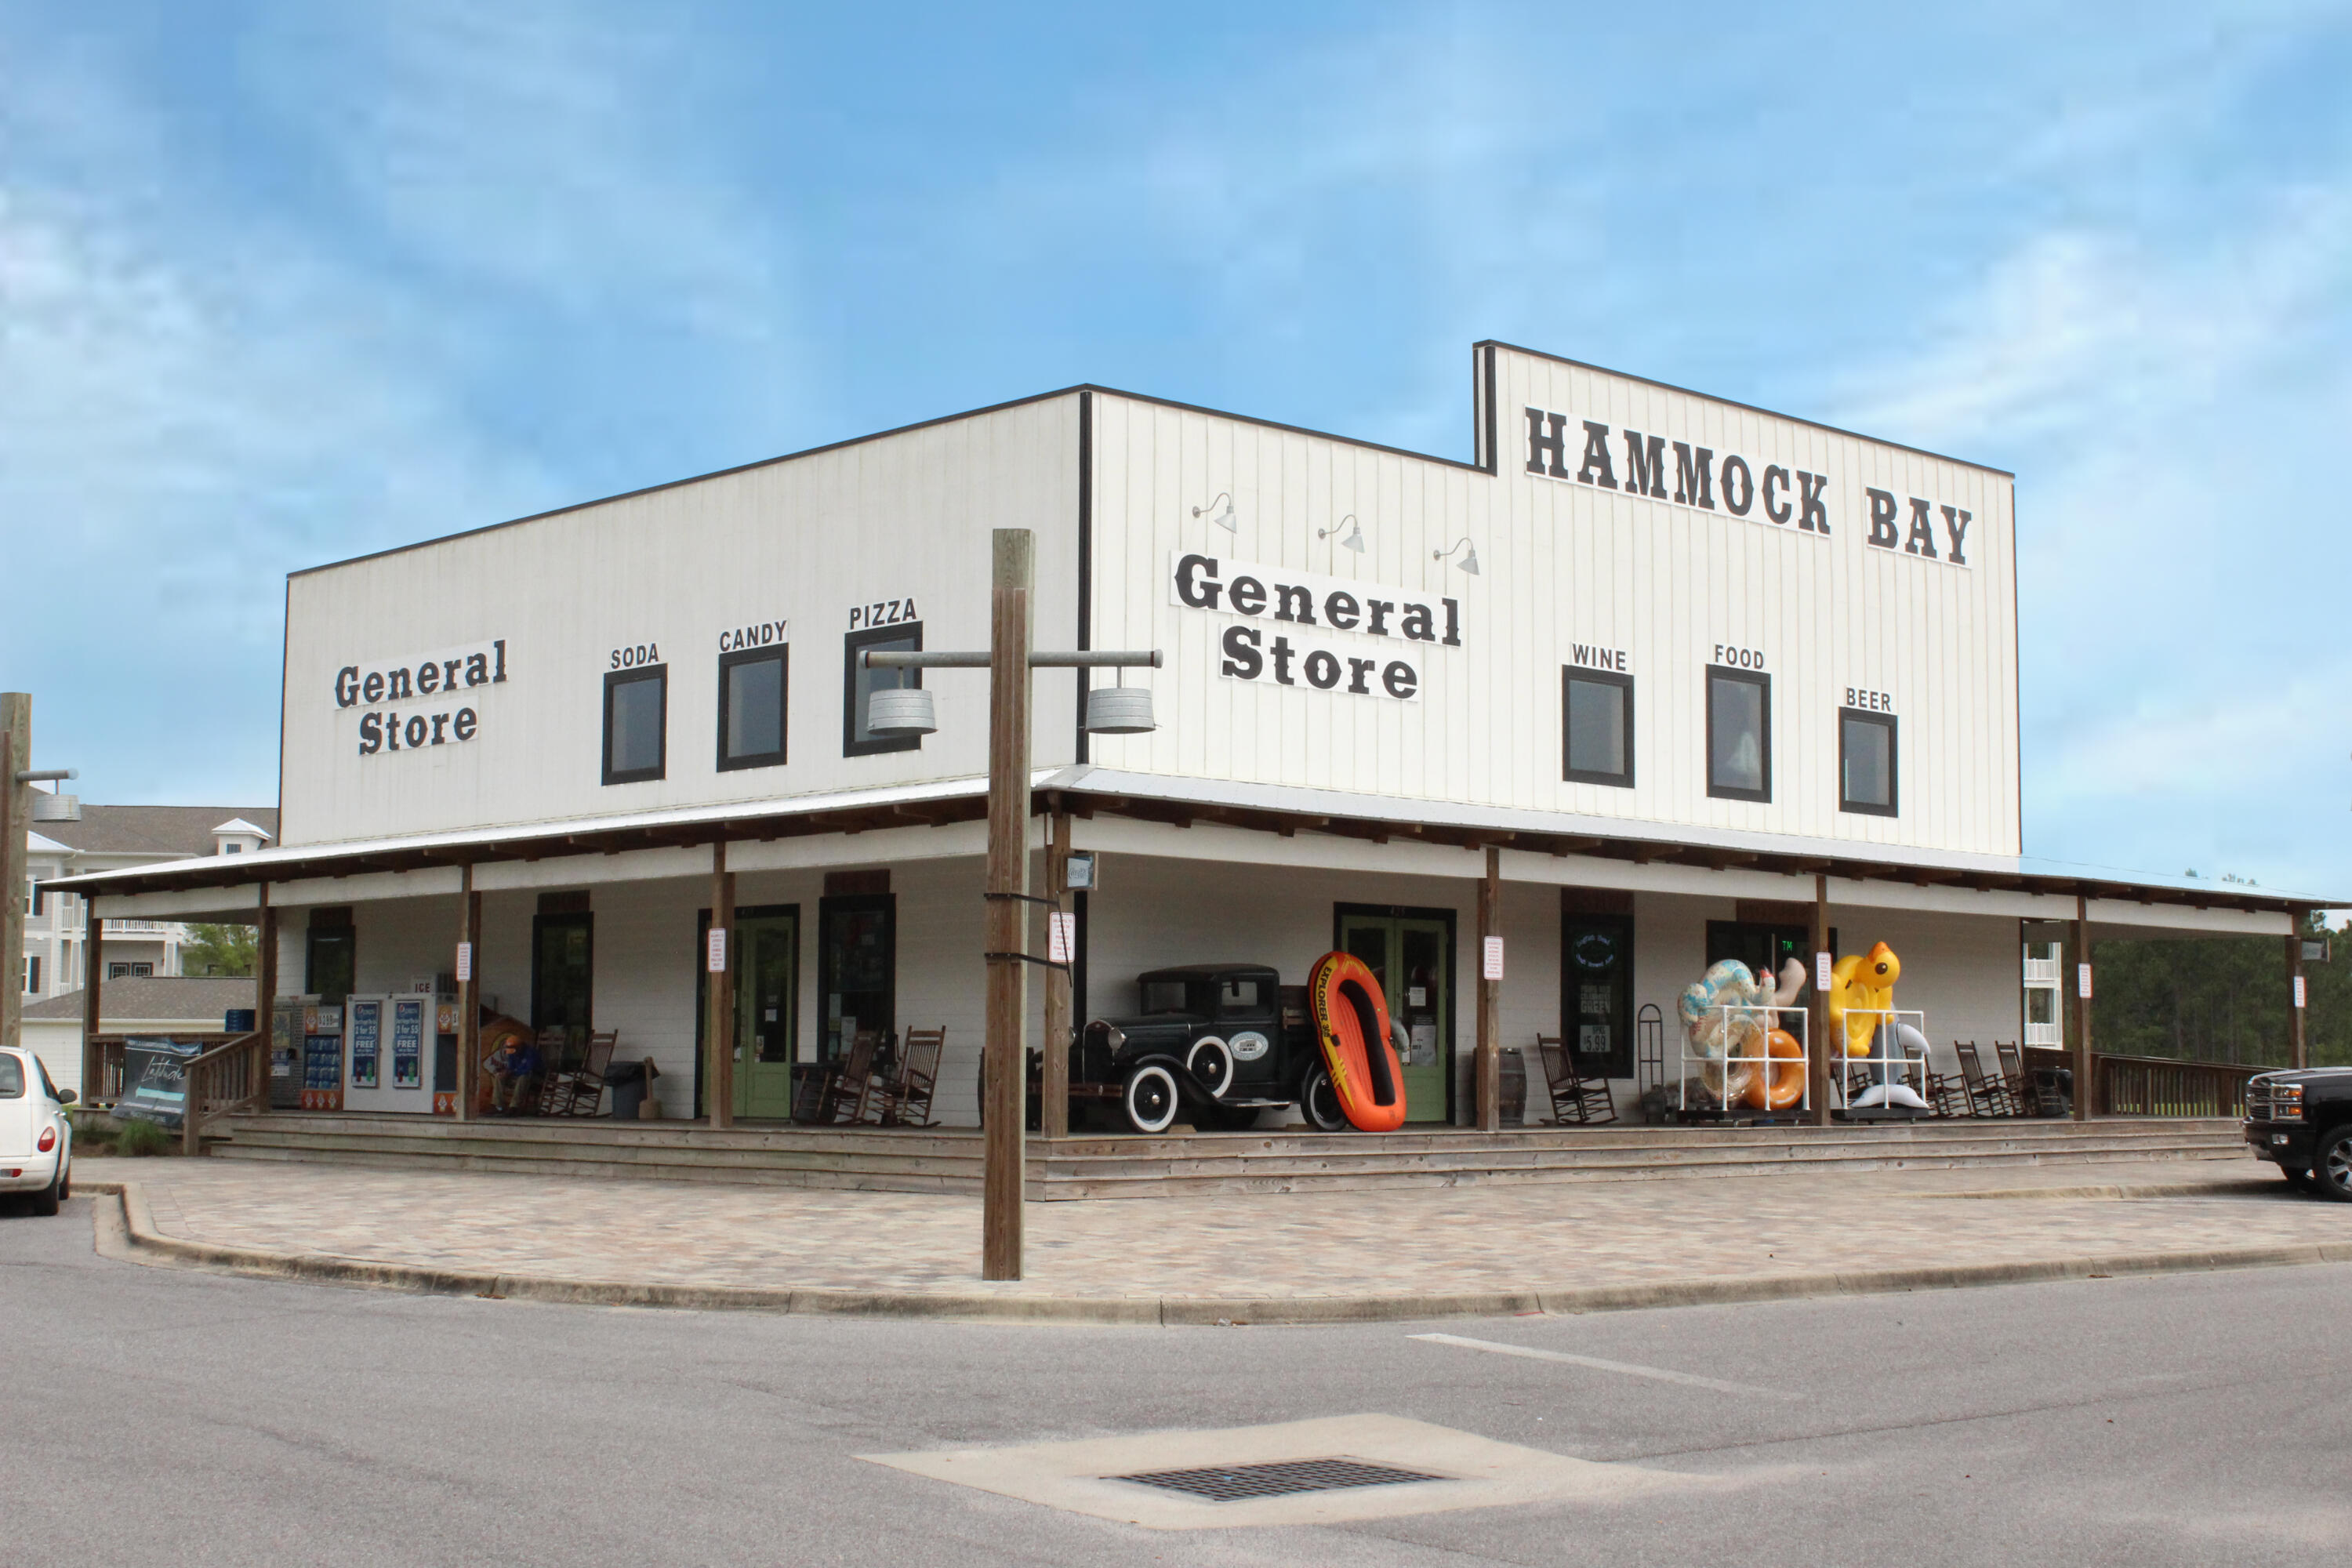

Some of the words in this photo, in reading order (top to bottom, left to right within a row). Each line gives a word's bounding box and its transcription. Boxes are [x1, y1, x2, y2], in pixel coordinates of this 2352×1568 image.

[1525, 406, 1831, 535] HAMMOCK
[1866, 486, 1972, 565] BAY
[850, 597, 917, 630] PIZZA
[1174, 554, 1461, 647] General
[719, 619, 787, 652] CANDY
[611, 643, 659, 670] SODA
[1222, 625, 1417, 699] Store
[1573, 643, 1627, 672] WINE
[1715, 644, 1764, 670] FOOD
[335, 639, 507, 708] General
[1846, 687, 1891, 712] BEER
[359, 707, 477, 754] Store
[415, 982, 430, 993] ICE
[1318, 966, 1332, 1021] EXPLORER
[1581, 1000, 1611, 1014] GREEN
[356, 1040, 375, 1048] FREE
[397, 1040, 416, 1048] FREE
[141, 1054, 187, 1083] Latitude
